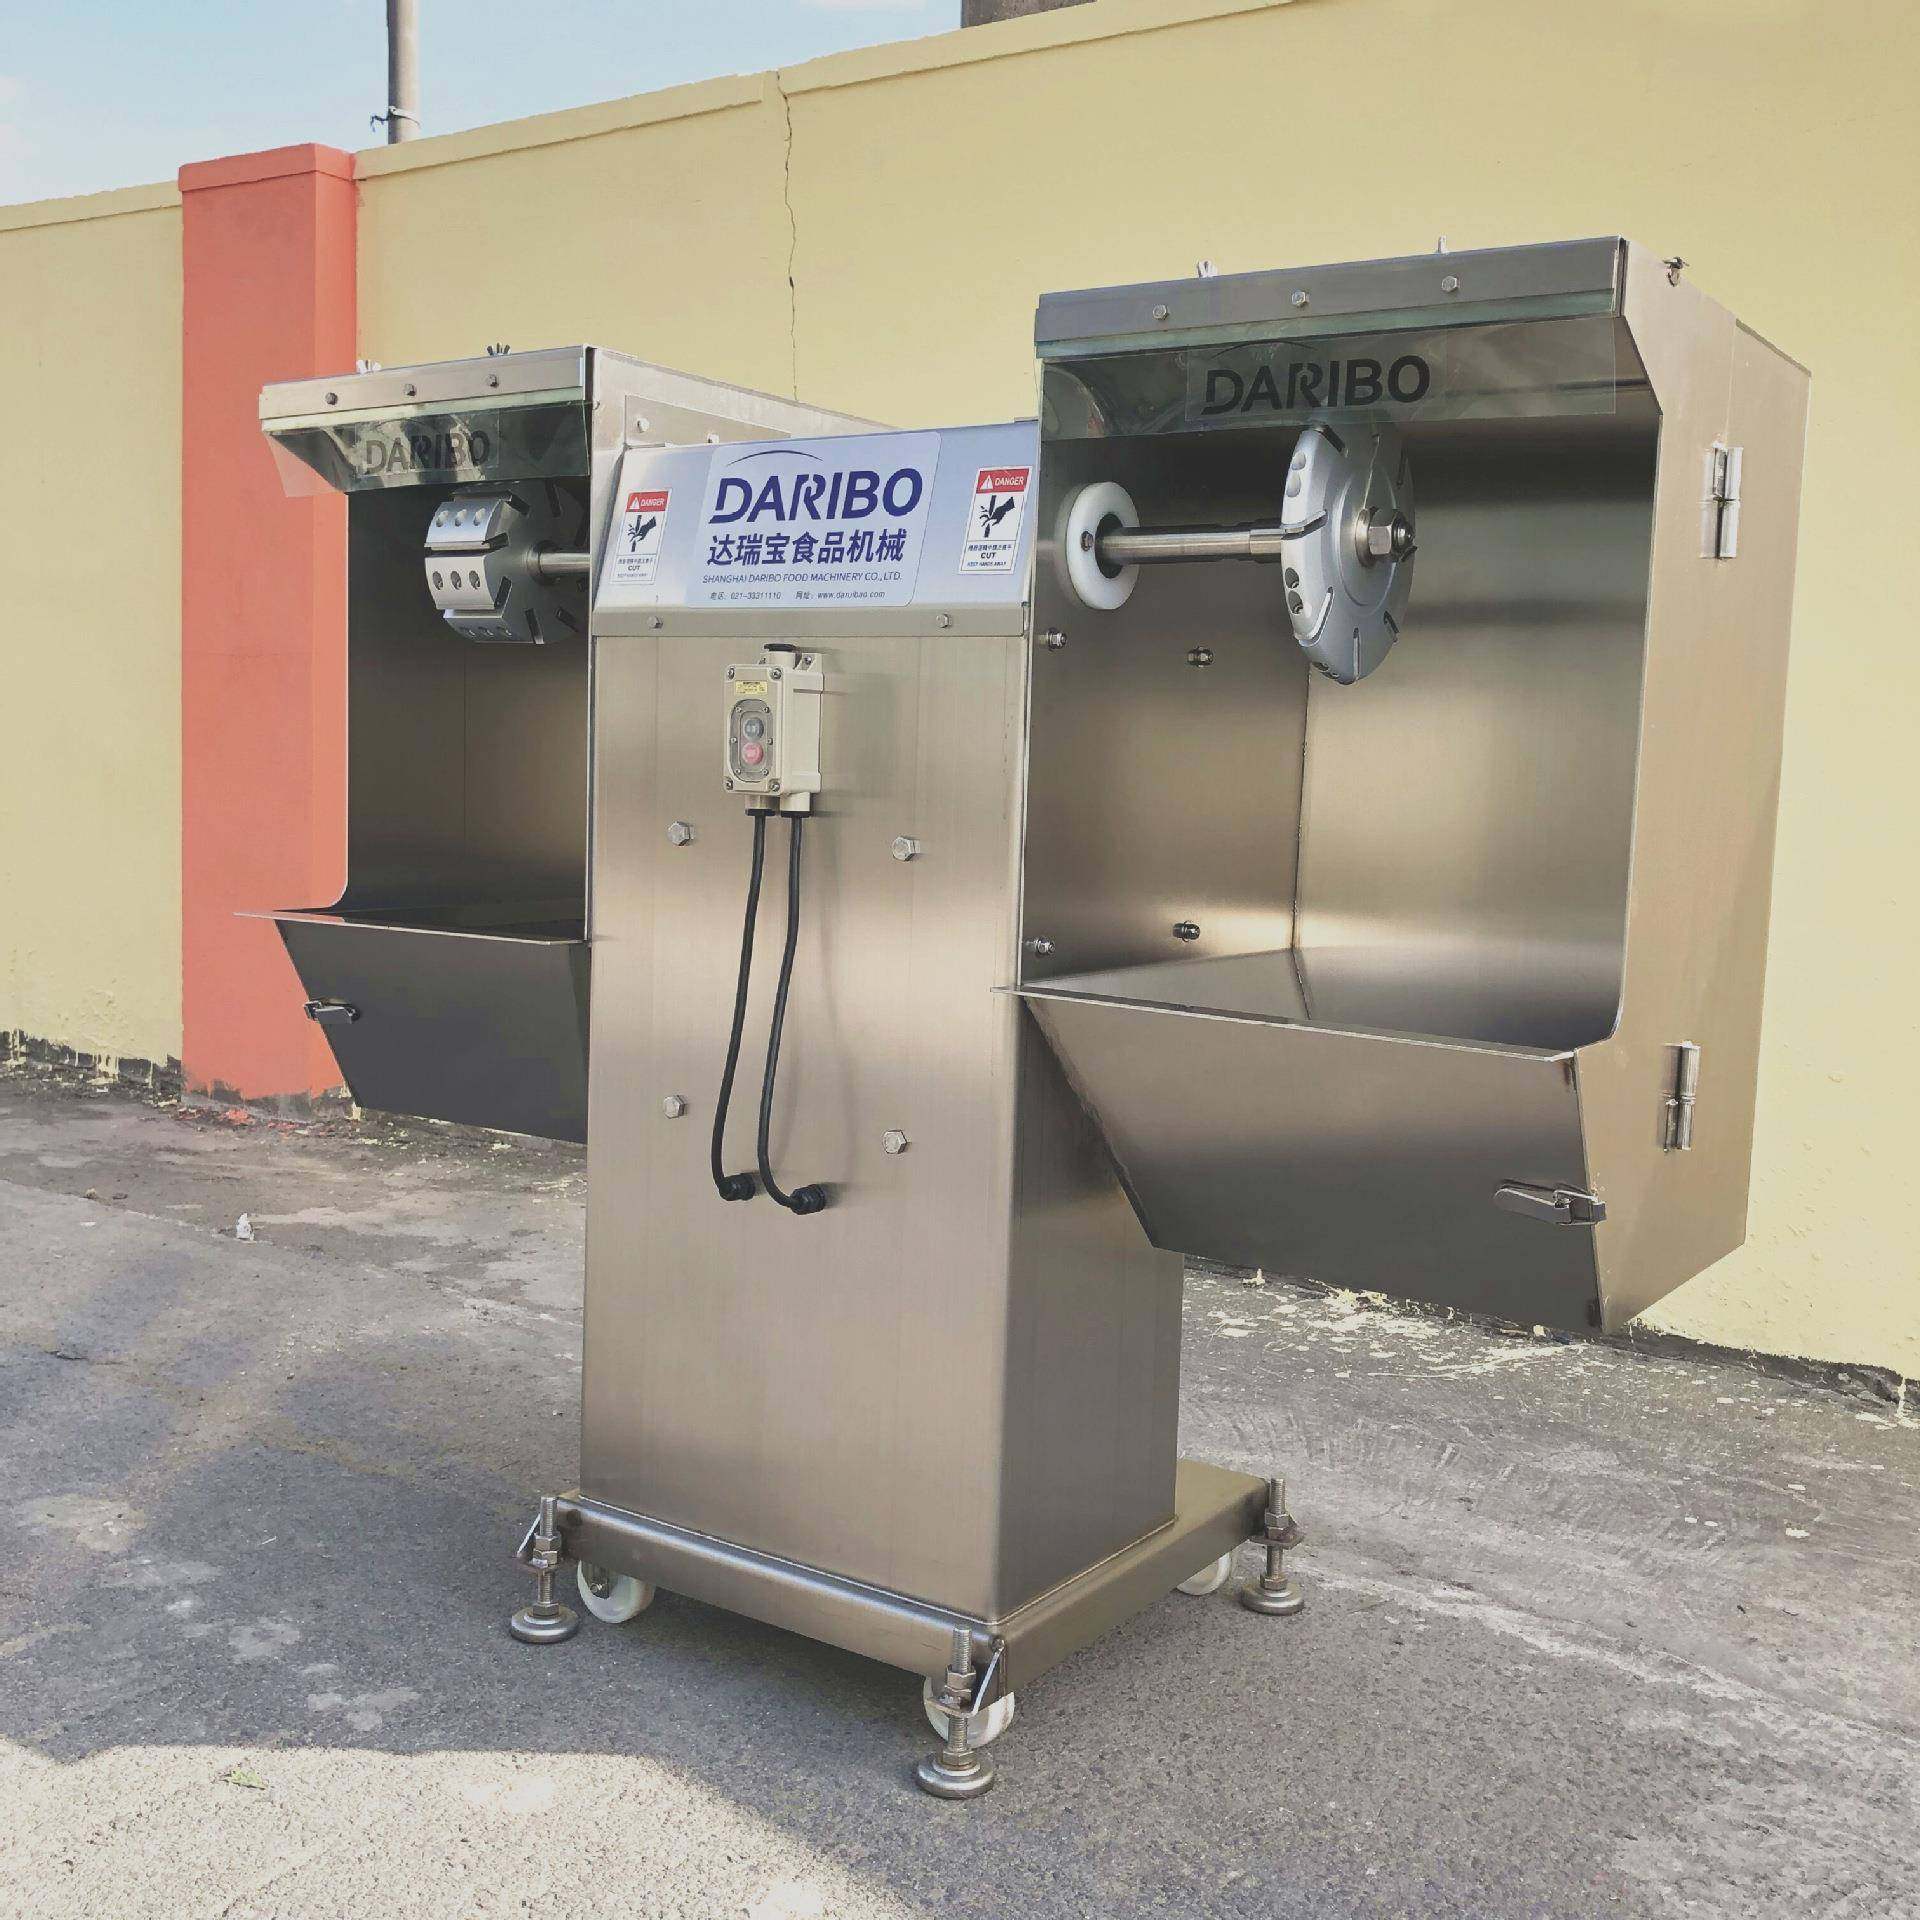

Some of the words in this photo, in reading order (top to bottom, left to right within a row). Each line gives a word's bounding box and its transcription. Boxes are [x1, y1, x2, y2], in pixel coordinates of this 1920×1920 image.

[1200, 355, 1431, 416] DARIBO
[364, 430, 490, 475] DARIBO
[708, 468, 923, 524] DARIBO
[994, 476, 1025, 486] DANGER
[640, 498, 665, 507] DANGER
[706, 528, 908, 566] 达瑞宝食品机械
[702, 574, 747, 584] SHANGHAI
[748, 573, 781, 583] DARIBO
[783, 573, 808, 582] FOOD
[810, 572, 864, 582] MACHINERY
